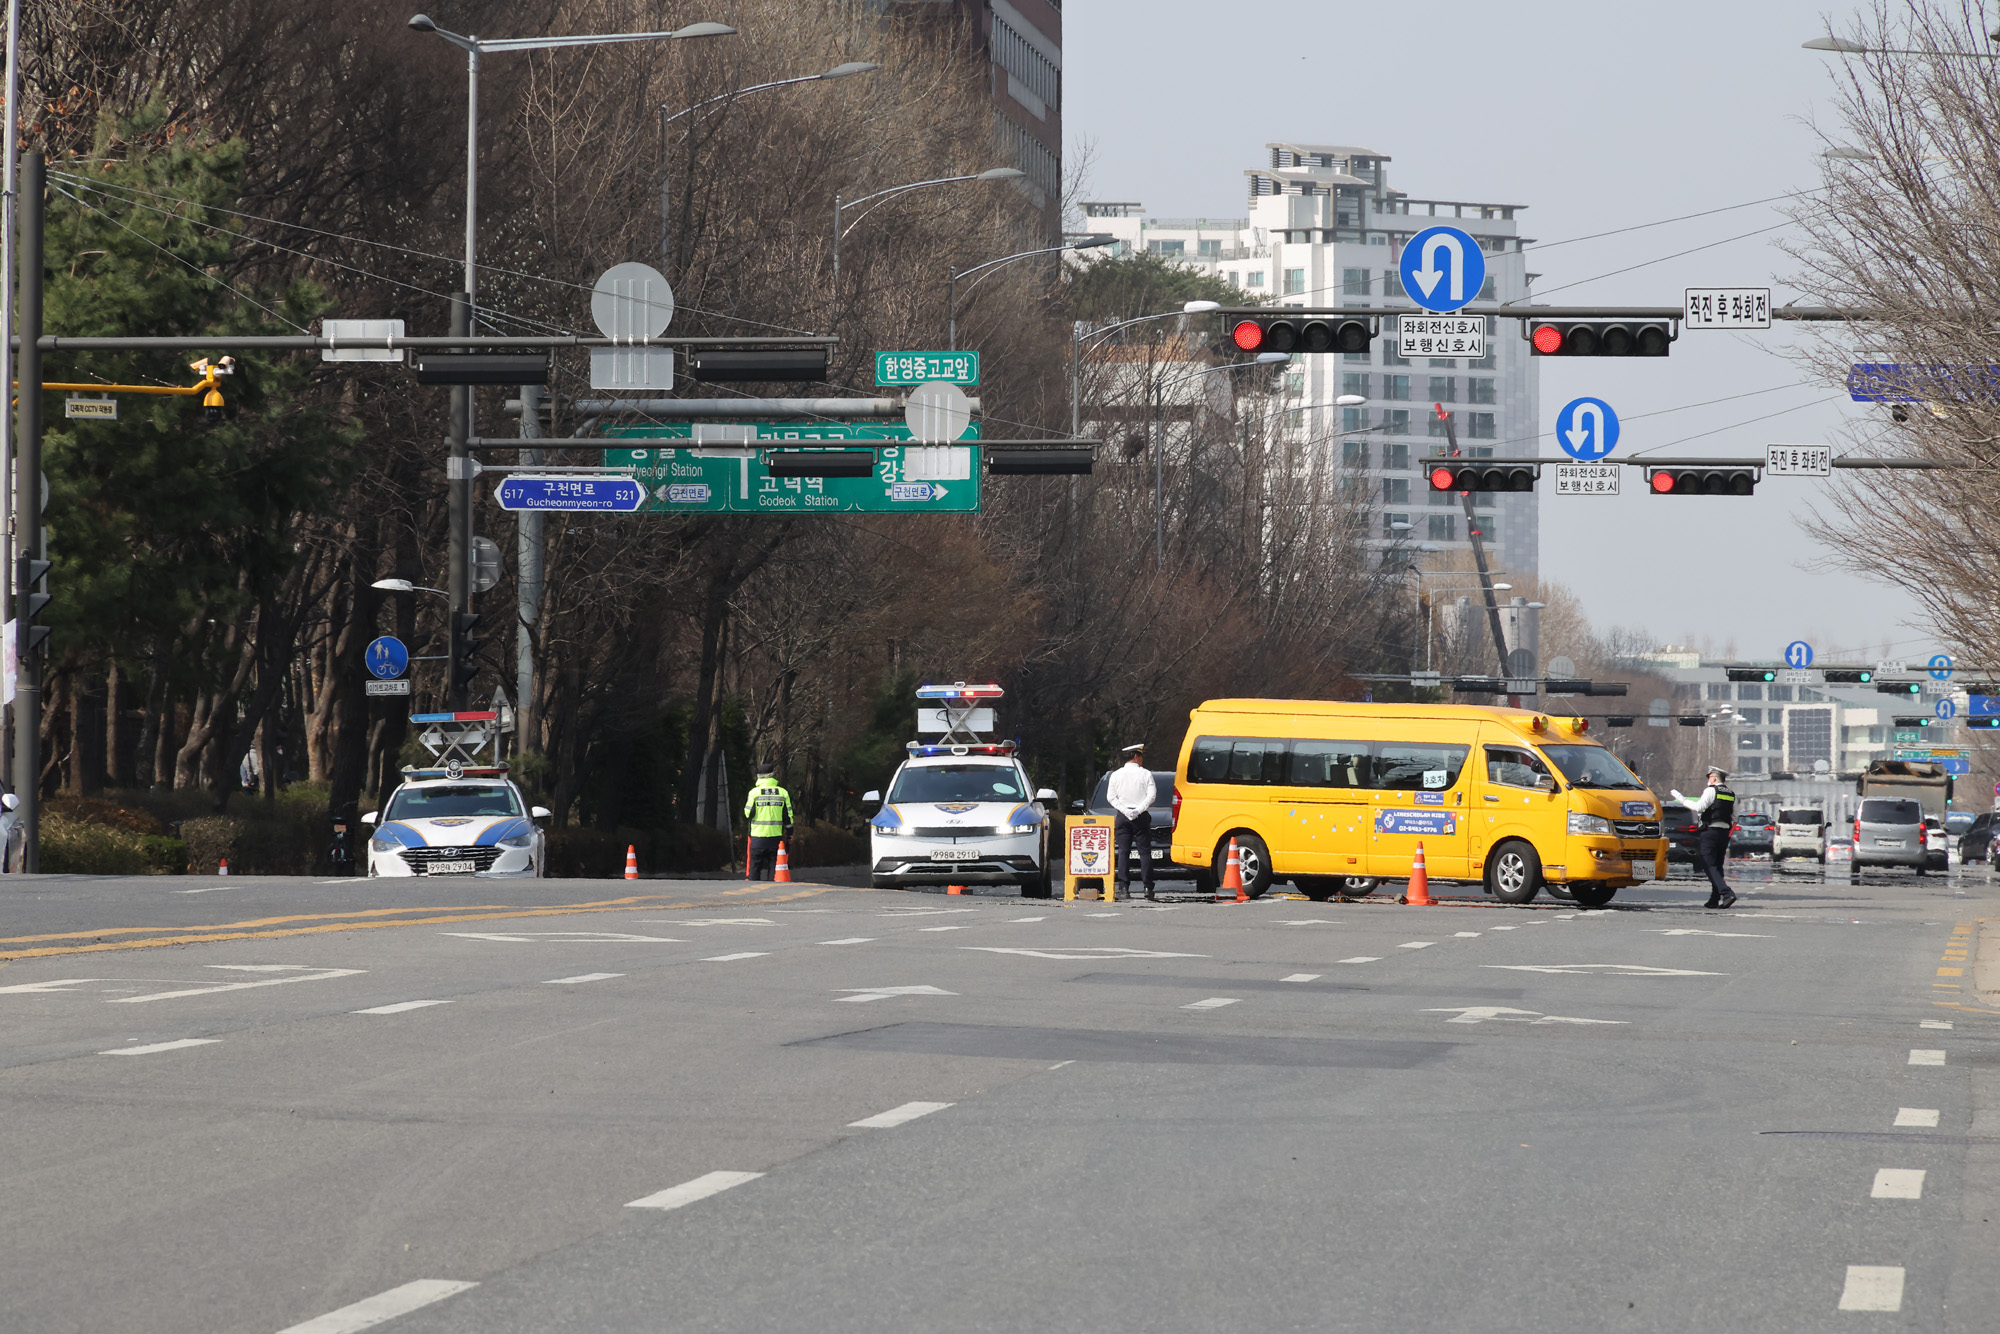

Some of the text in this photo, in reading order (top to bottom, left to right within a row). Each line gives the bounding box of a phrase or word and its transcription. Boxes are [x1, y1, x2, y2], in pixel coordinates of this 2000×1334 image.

[1690, 295, 1767, 323] 직진 후 좌회전
[1403, 319, 1481, 335] 좌회전신호시
[1403, 337, 1482, 354] 보행신호시
[885, 357, 969, 380] 한영중고교앞
[85, 405, 98, 413] CCTV
[1770, 450, 1828, 471] 직진 후 좌회전
[671, 462, 703, 477] Station
[1559, 467, 1617, 479] 좌회전신호시
[543, 482, 595, 497] 구천면로
[759, 476, 823, 494] 고덕역
[1559, 480, 1617, 493] 보행신호시
[504, 489, 524, 500] 517
[615, 490, 634, 501] 521
[671, 488, 706, 499] 구천면로
[894, 486, 928, 498] 구천면로
[526, 497, 613, 509] Gucheonmyeon-ro
[759, 494, 838, 506] Godeok Station
[1072, 828, 1107, 840] 음주운전
[956, 851, 976, 859] 2910
